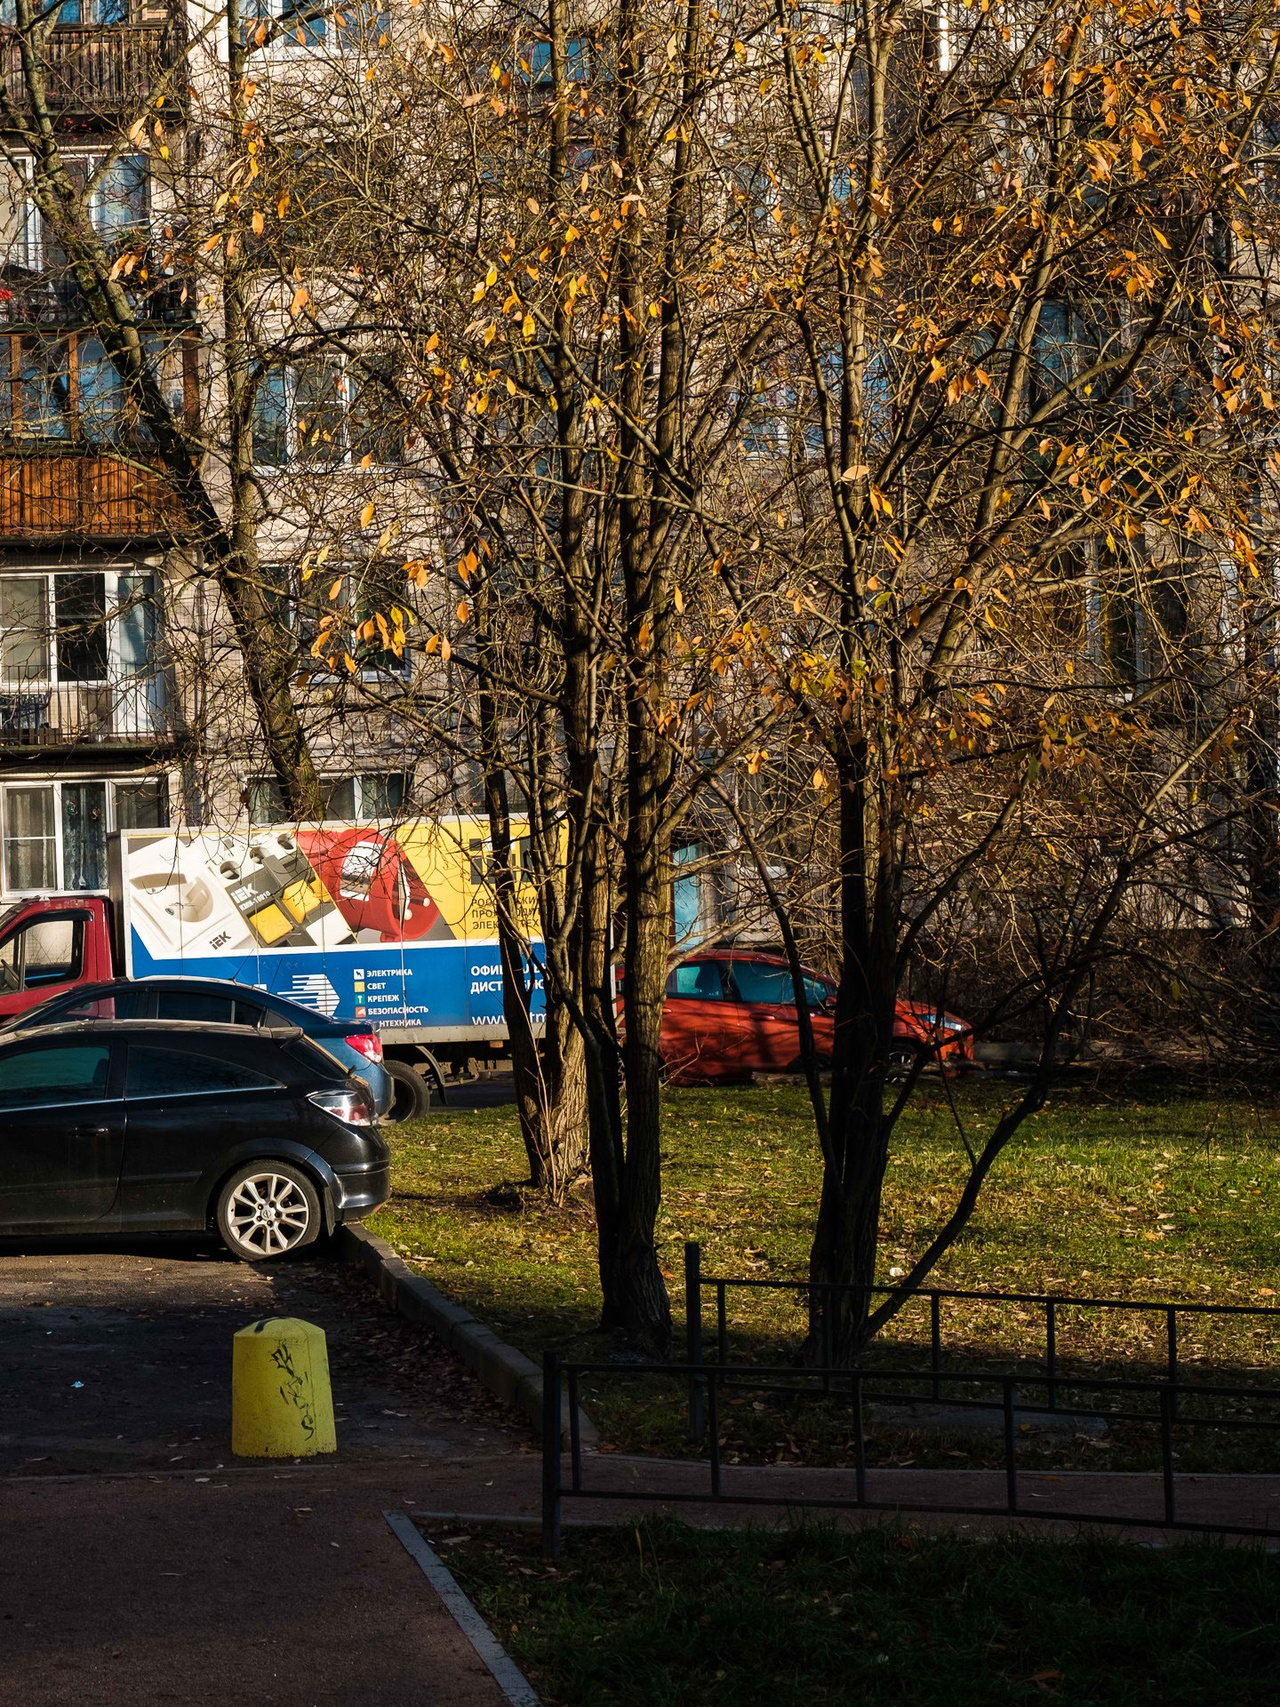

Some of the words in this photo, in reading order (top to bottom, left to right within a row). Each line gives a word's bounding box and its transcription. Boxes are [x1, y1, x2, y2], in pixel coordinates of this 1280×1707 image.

[366, 968, 413, 978] ЭЛЕКТРИКА
[367, 982, 386, 990] СВЕТ
[367, 994, 400, 1003] КРЕПЕЖ
[367, 1006, 429, 1016] БЕЗОПАСНОСТЬ
[379, 1018, 422, 1027] НТЕХНИКА
